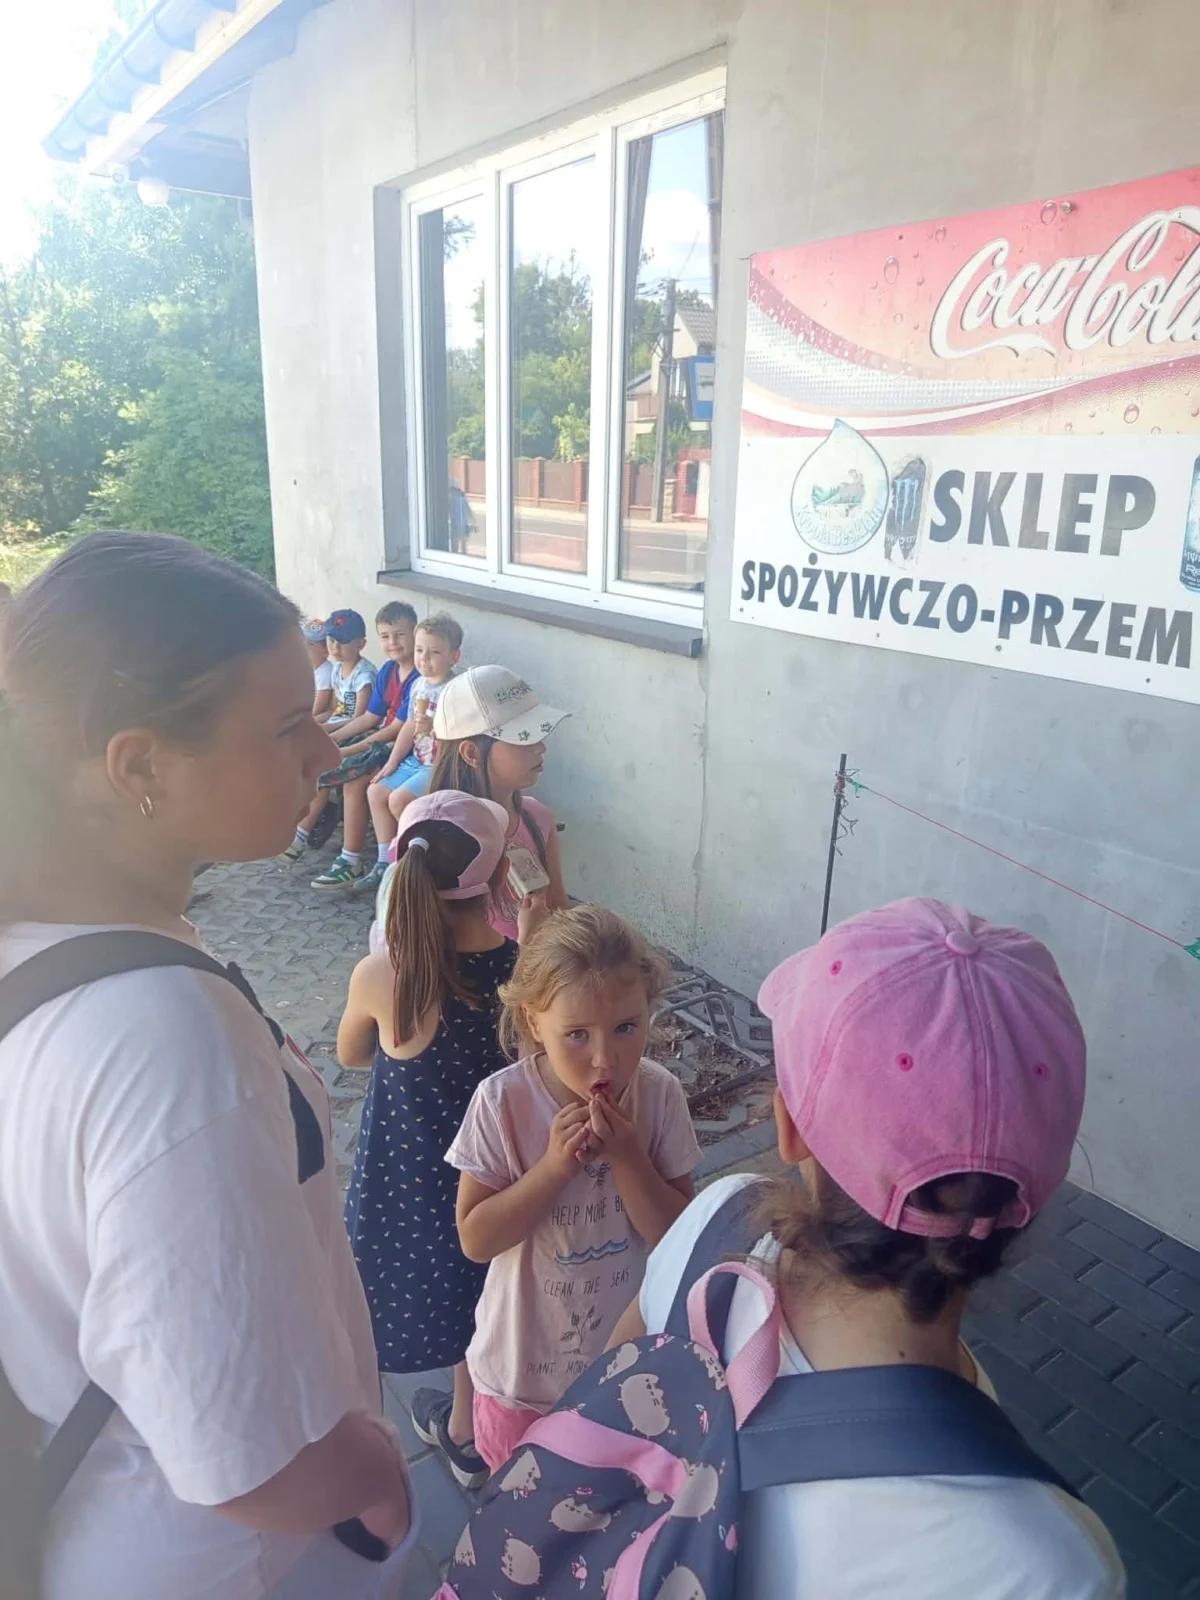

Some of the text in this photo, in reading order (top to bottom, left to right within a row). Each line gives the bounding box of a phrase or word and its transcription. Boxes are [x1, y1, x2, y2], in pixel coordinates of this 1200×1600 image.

[929, 469, 1156, 556] SKLEP
[741, 552, 1193, 669] SPOŻYWCZO-PRZEM
[551, 1204, 580, 1226] HELP
[585, 1196, 607, 1225] MORE
[544, 1267, 629, 1298] CLEAN THE SEAS
[526, 1361, 557, 1376] PLANT
